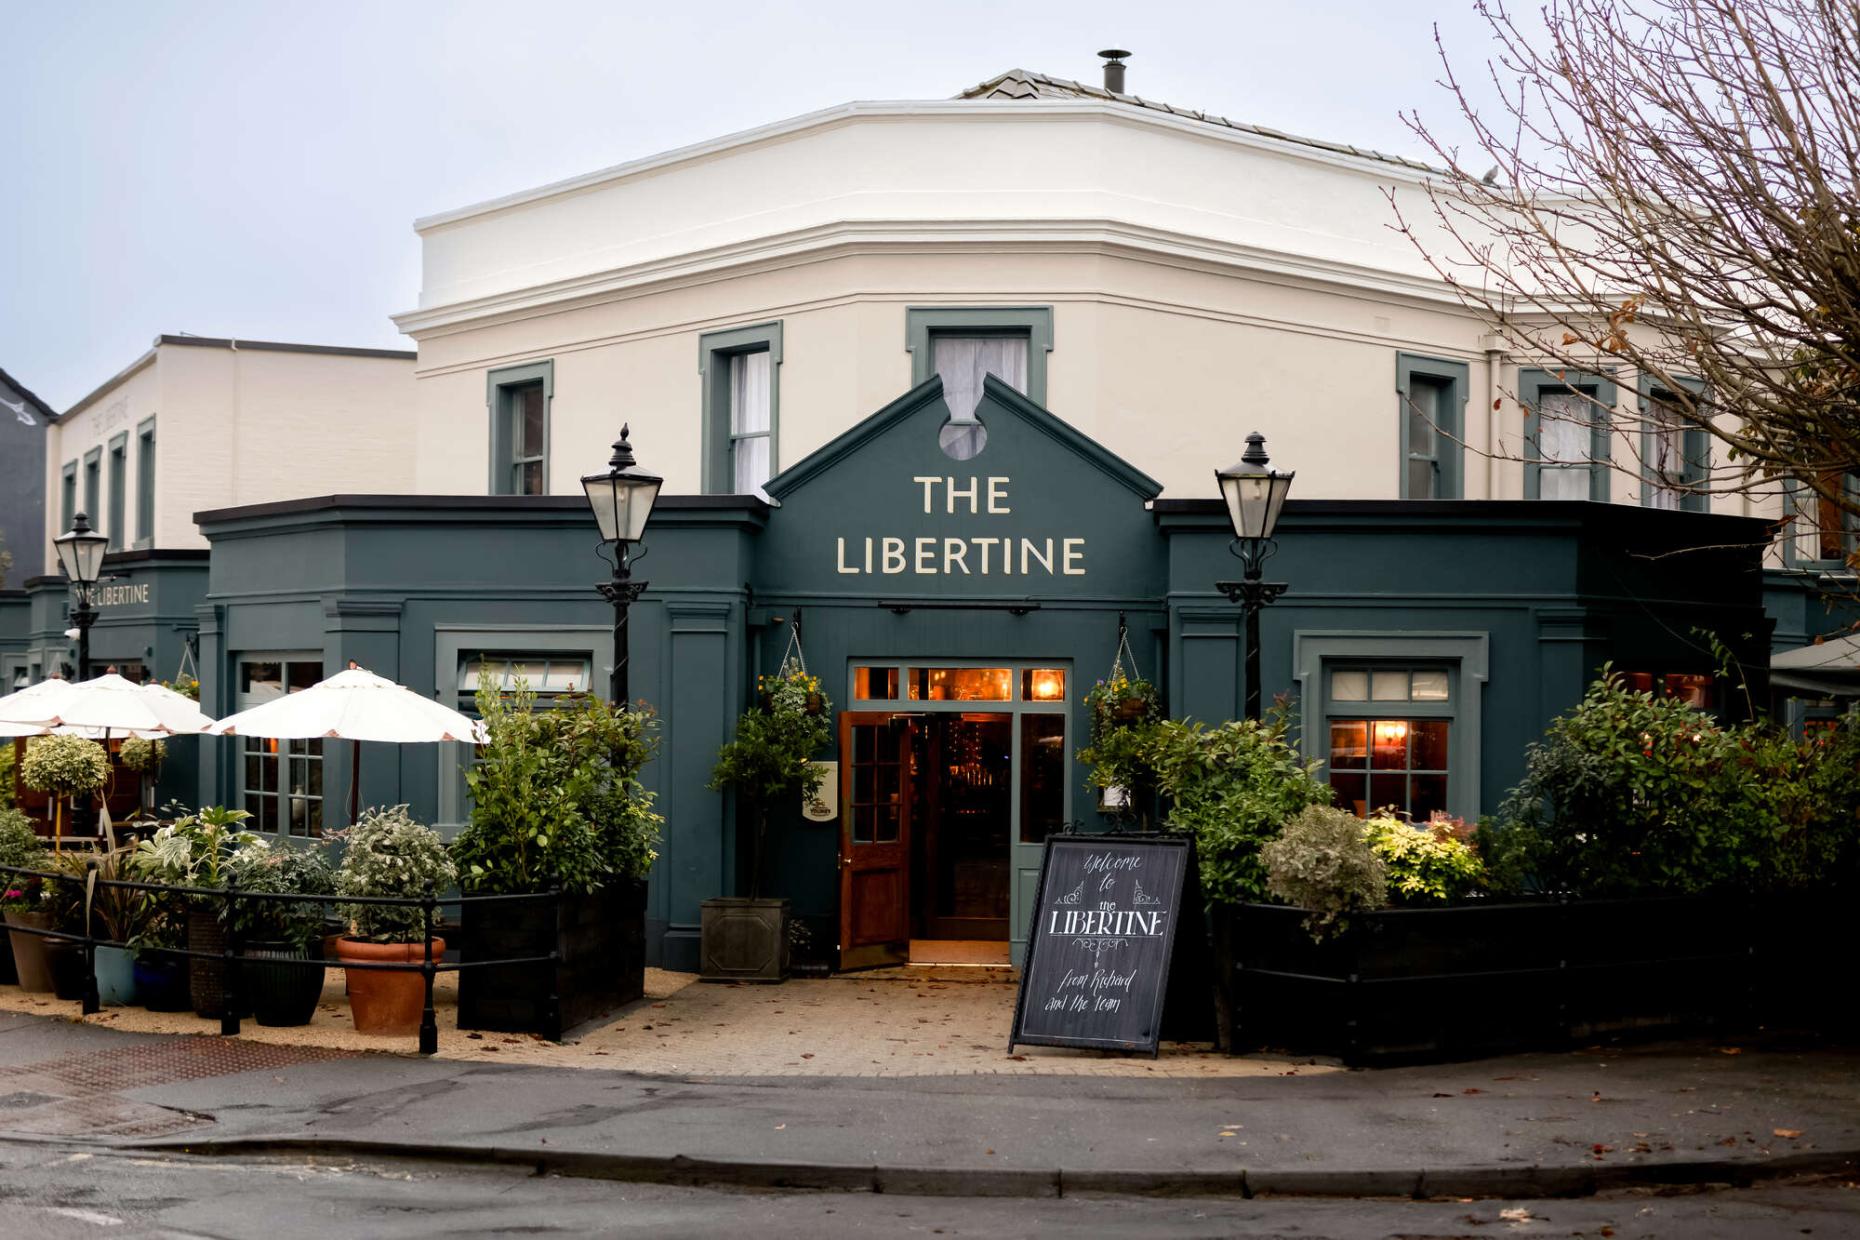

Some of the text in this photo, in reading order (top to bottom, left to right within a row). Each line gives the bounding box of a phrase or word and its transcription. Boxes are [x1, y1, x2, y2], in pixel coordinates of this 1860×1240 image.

[913, 476, 1011, 514] THE
[837, 536, 1086, 575] LIBERTINE
[97, 584, 149, 606] LIBERTINE
[1083, 852, 1142, 874] Welcome
[1099, 873, 1117, 892] to
[1099, 901, 1117, 912] the
[1049, 910, 1167, 936] LIBERTINE
[1057, 968, 1137, 997] from Richard
[1045, 994, 1121, 1014] and the team
